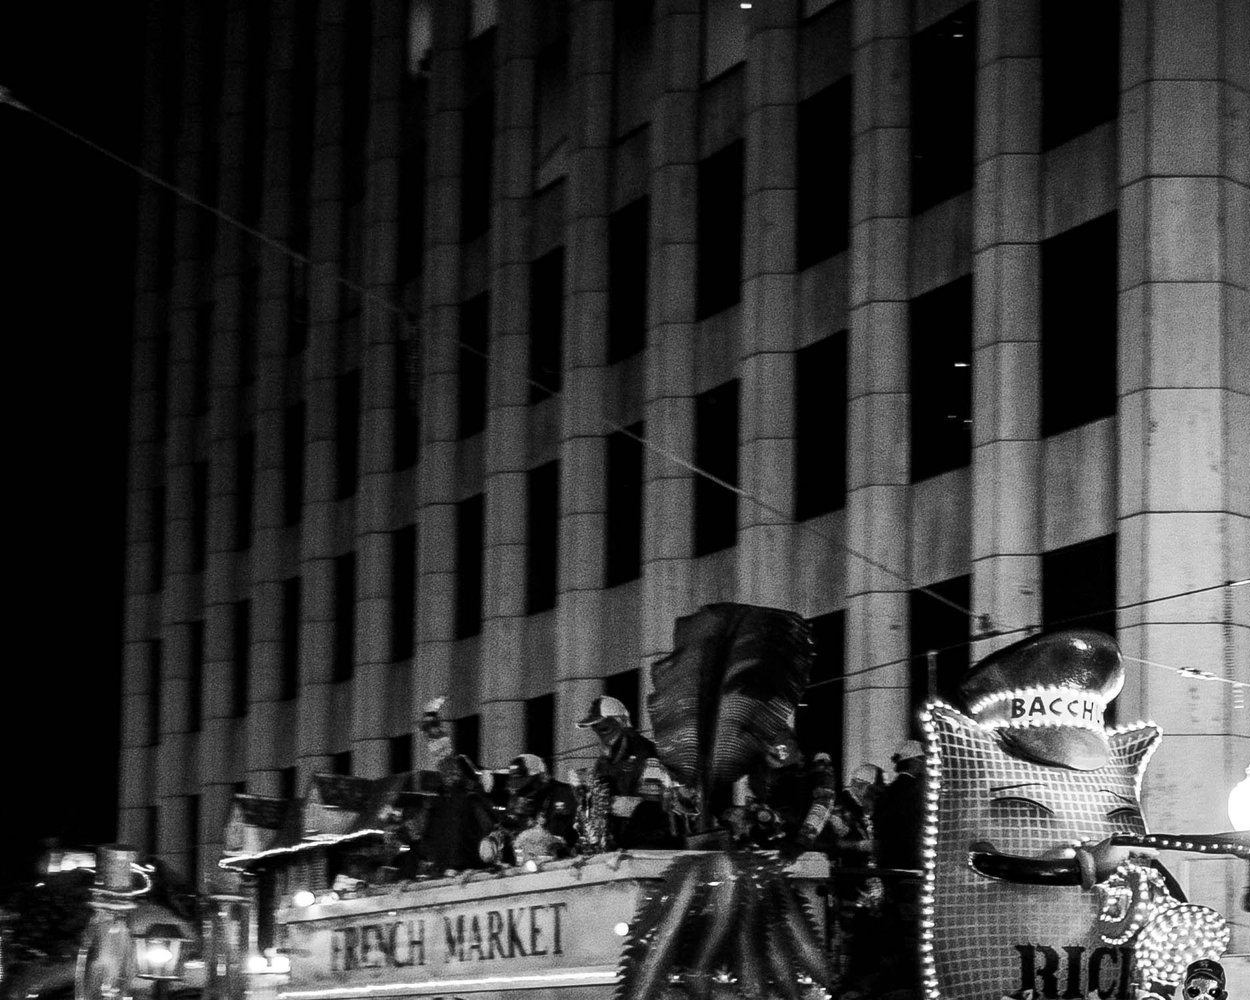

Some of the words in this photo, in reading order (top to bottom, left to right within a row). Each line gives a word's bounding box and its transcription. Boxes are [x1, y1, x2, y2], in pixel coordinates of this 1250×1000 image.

[1011, 696, 1099, 723] BACCH
[331, 920, 425, 971] FRENCH
[444, 903, 566, 964] MARKET
